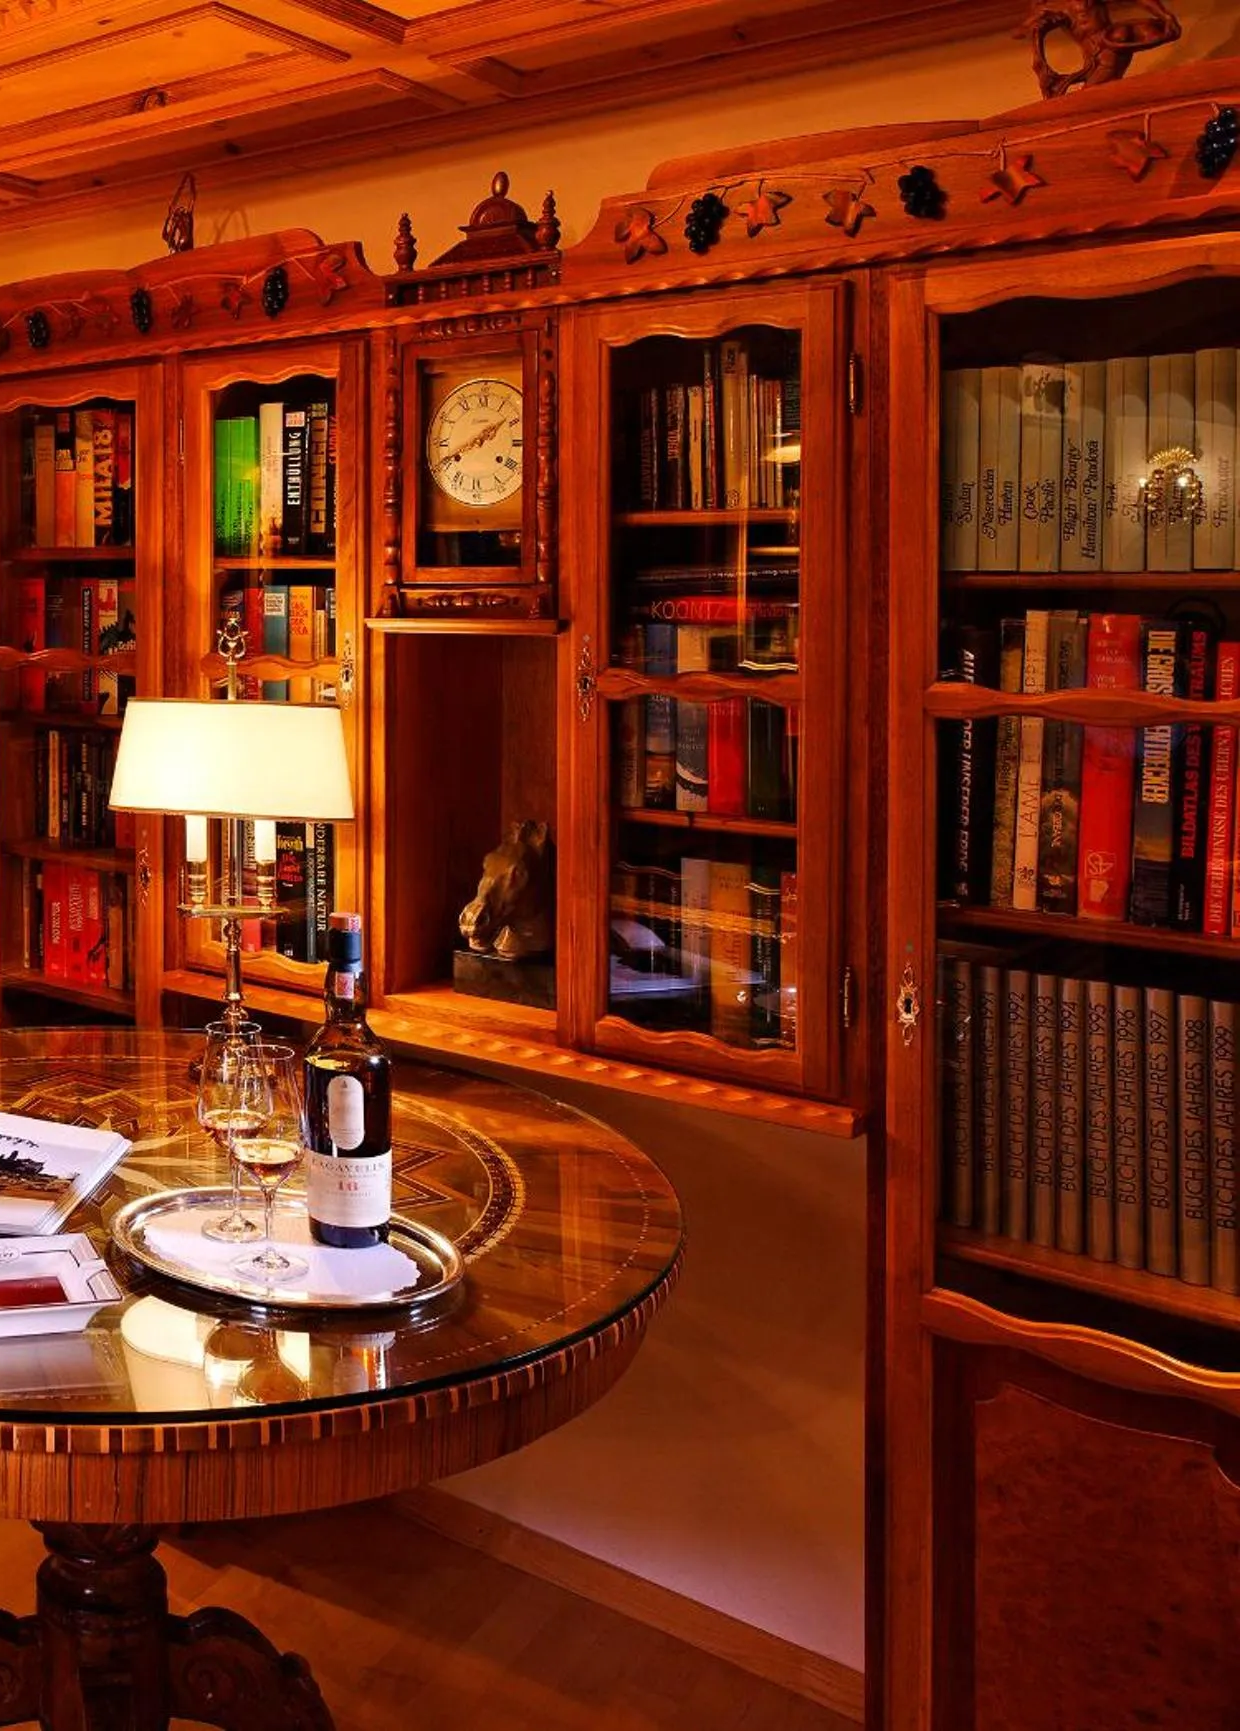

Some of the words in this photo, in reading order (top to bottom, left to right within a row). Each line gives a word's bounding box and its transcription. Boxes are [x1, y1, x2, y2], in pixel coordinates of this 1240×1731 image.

[93, 429, 113, 455] 18
[286, 432, 301, 505] ENTHÜLLUNG
[1064, 438, 1082, 496] Bounty
[1083, 440, 1099, 494] Pandora
[95, 459, 113, 525] MILA
[1024, 482, 1039, 520] Cook
[1106, 483, 1118, 519] Park
[1063, 504, 1078, 541] Bligh
[1081, 503, 1097, 560] Hamilton
[651, 600, 724, 620] KOONTZ
[1148, 631, 1177, 653] DIE
[1141, 726, 1172, 804] ENTDECKER
[1185, 735, 1202, 768] DES
[1179, 770, 1200, 859] BILDATLAS
[1214, 784, 1228, 808] DES
[1210, 811, 1228, 898] GEHEIMNISSE
[316, 888, 327, 932] NATUR
[1208, 899, 1222, 923] DIE
[1007, 992, 1025, 1025] 1992
[1035, 996, 1053, 1029] 1993
[1058, 1002, 1078, 1034] 1994
[1088, 1003, 1107, 1037] 1995
[1116, 1009, 1137, 1043] 1996
[1149, 1011, 1170, 1046] 1997
[1184, 1019, 1206, 1054] 1998
[1215, 1026, 1237, 1062] 1999
[1007, 1031, 1025, 1090] JAHRES
[1035, 1037, 1053, 1093] JAHRES
[1058, 1042, 1078, 1102] JAHRES
[1088, 1045, 1107, 1105] JAHRES
[1116, 1050, 1137, 1111] JAHRES
[1149, 1054, 1170, 1116] JAHRES
[1184, 1061, 1206, 1124] JAHRES
[1215, 1070, 1237, 1132] JAHRES
[1007, 1096, 1025, 1126] DES
[1035, 1101, 1053, 1132] DES
[1058, 1107, 1078, 1138] DES
[1088, 1111, 1107, 1144] DES
[1116, 1117, 1137, 1149] DES
[1149, 1120, 1170, 1153] DES
[1184, 1131, 1206, 1163] DES
[1007, 1130, 1025, 1181] BUCH
[1035, 1138, 1053, 1186] BUCH
[1058, 1143, 1078, 1192] BUCH
[1088, 1148, 1107, 1198] BUCH
[1215, 1138, 1237, 1173] DES
[1116, 1154, 1137, 1204] BUCH
[1149, 1157, 1170, 1210] BUCH
[1184, 1168, 1206, 1220] BUCH
[1215, 1177, 1237, 1231] BUCH
